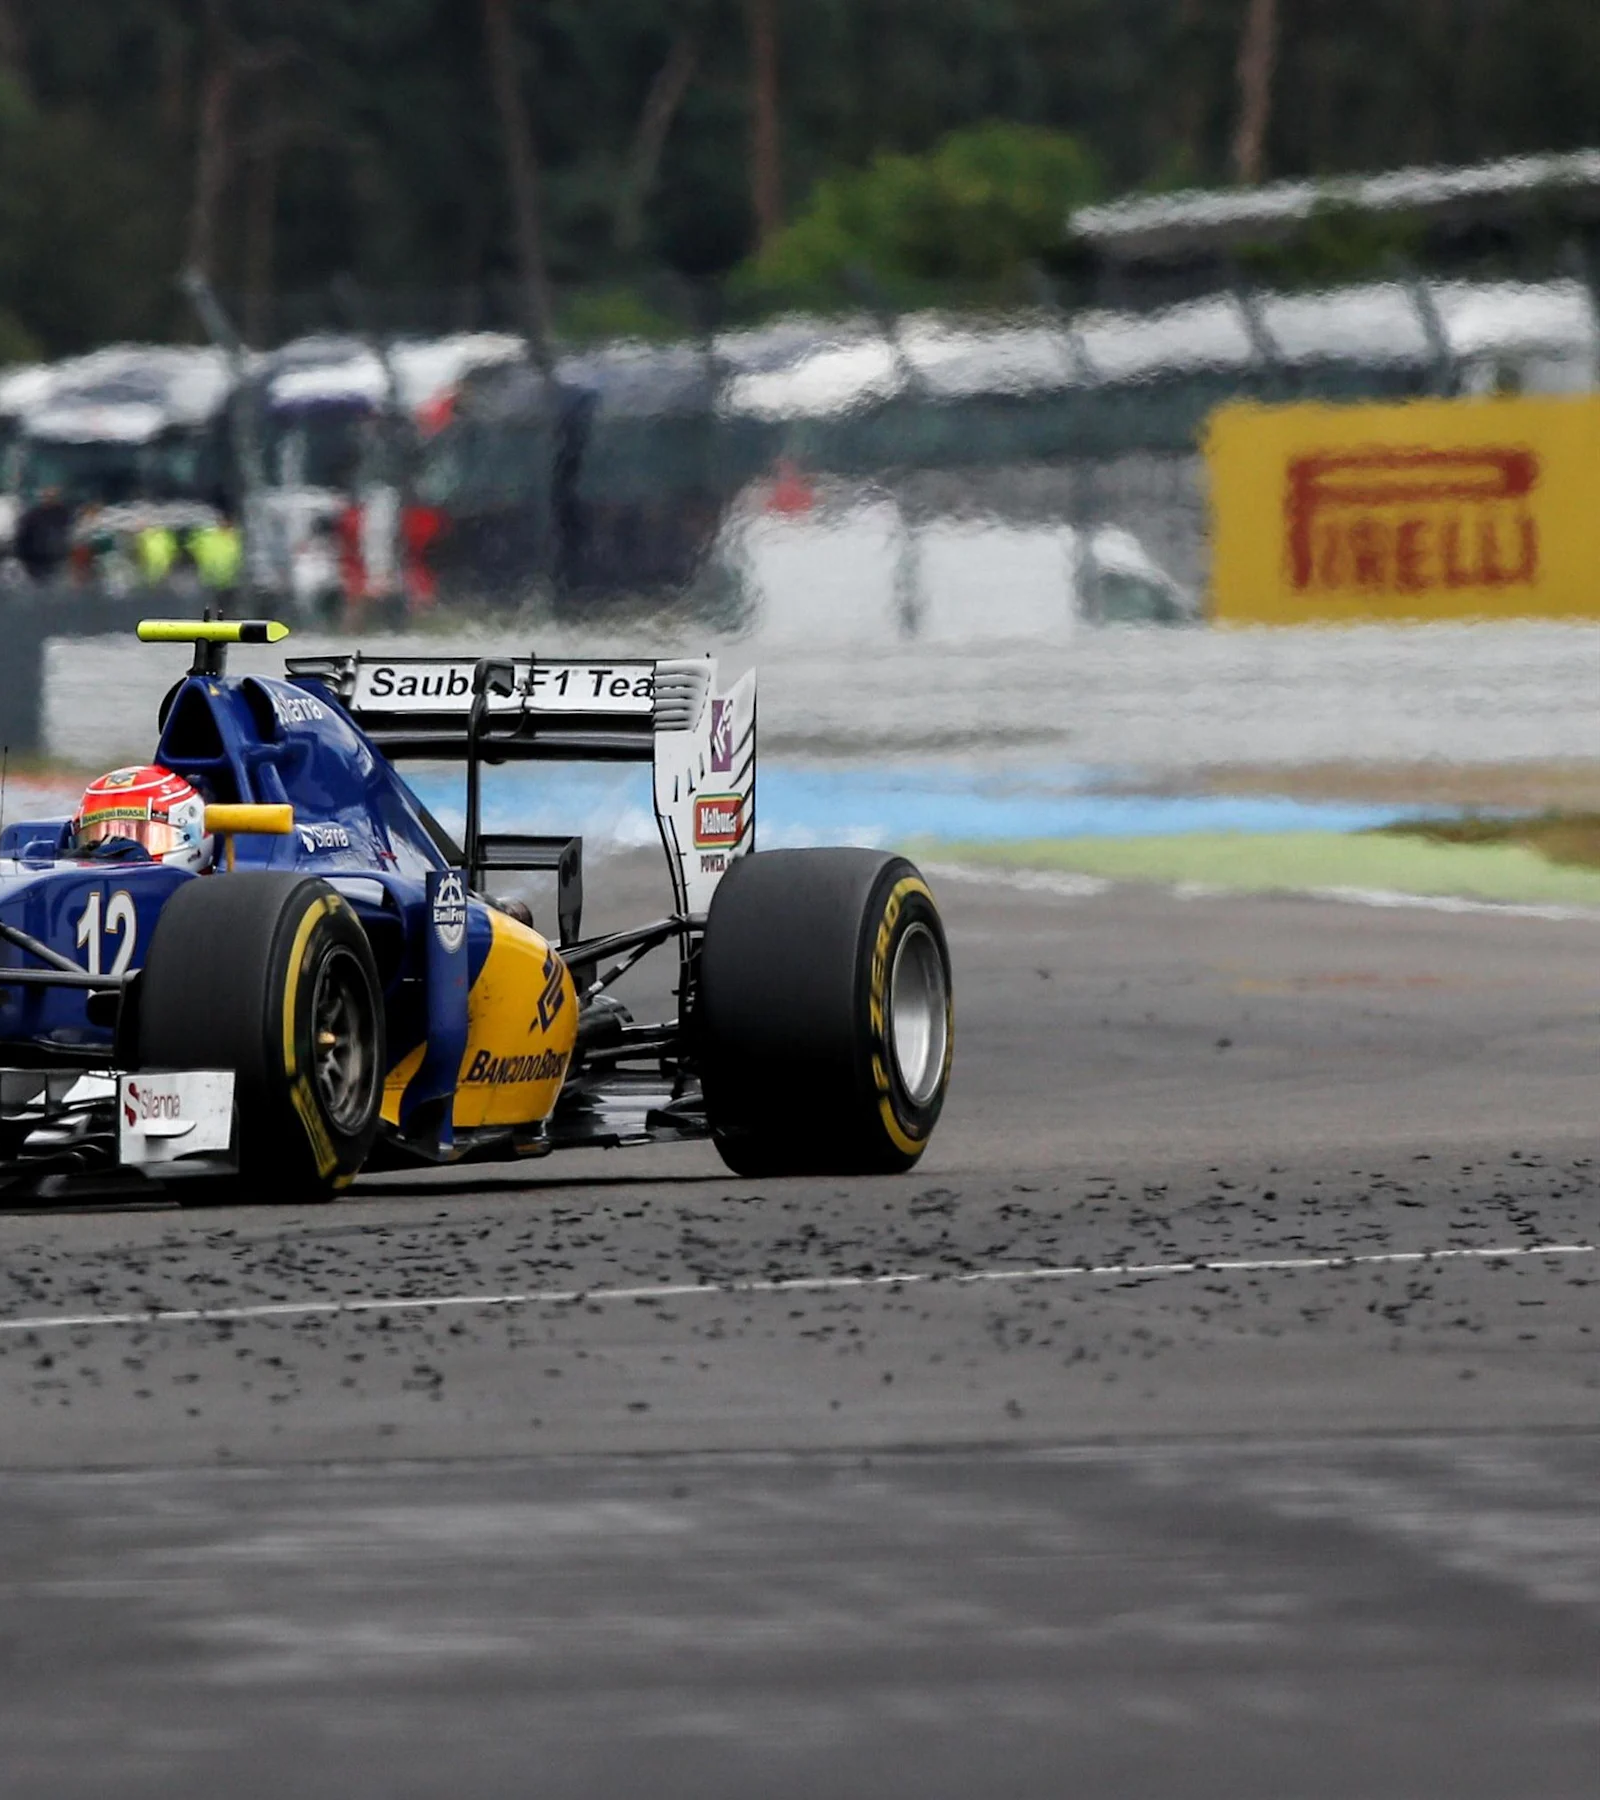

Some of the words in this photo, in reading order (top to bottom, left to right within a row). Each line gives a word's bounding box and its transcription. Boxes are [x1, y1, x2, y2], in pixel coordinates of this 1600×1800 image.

[369, 667, 498, 697] Saub
[524, 669, 570, 696] F1
[589, 670, 656, 697] Tea
[77, 889, 138, 990] 12
